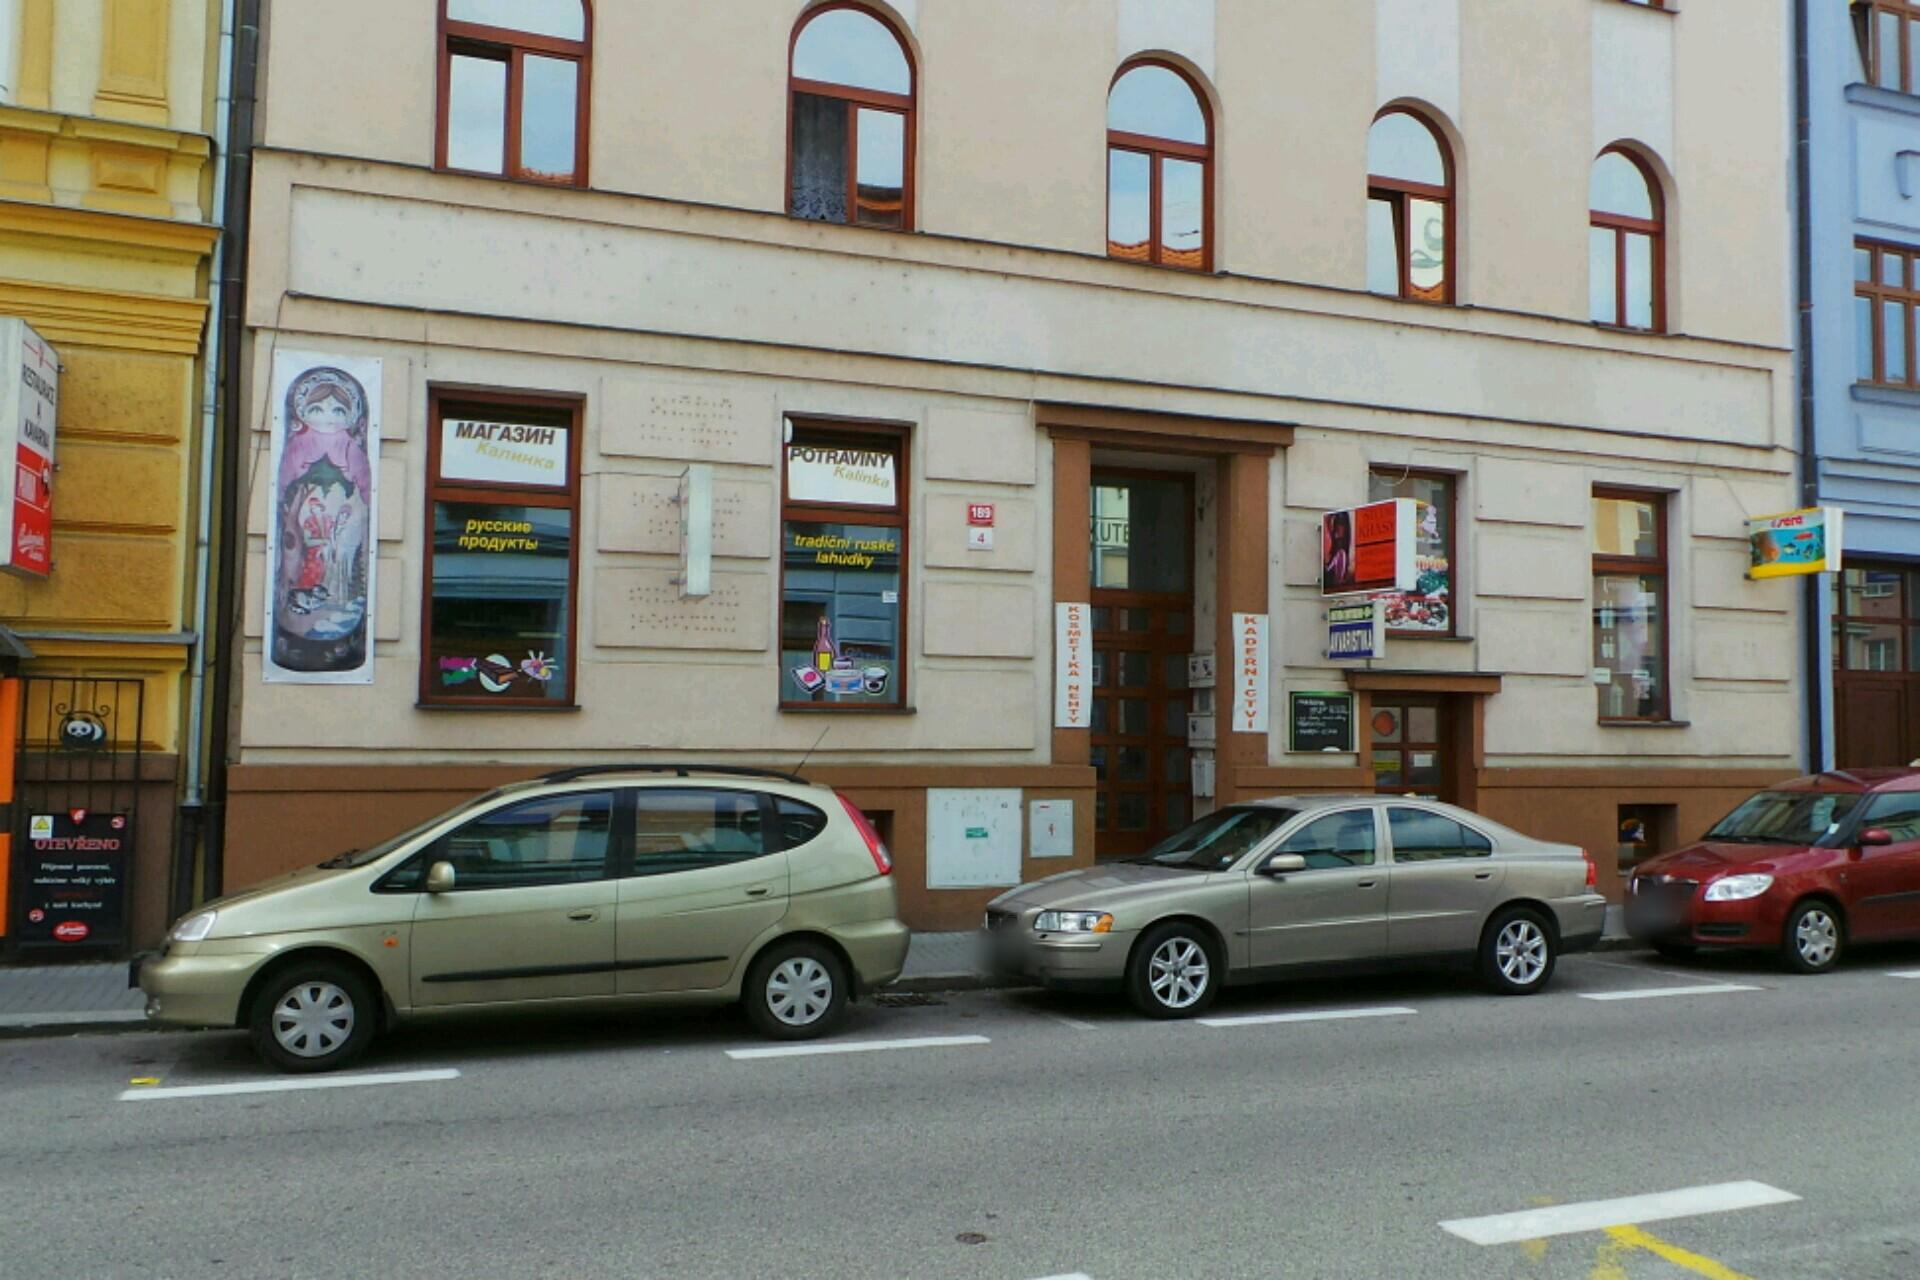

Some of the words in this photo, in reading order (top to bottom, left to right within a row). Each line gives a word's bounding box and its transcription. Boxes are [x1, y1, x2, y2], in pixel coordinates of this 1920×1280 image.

[455, 422, 555, 445] МАГАЗИН
[476, 441, 556, 470] Калинка
[790, 447, 890, 469] POTRAVINY
[833, 464, 890, 489] Kalinka
[466, 519, 532, 534] русские
[976, 532, 985, 543] 4
[458, 535, 538, 552] продукты
[794, 533, 850, 549] tradiční
[1067, 606, 1081, 677] KOSMETIKA
[1067, 684, 1080, 724] NEHTY
[34, 836, 120, 850] OTEVŘENO
